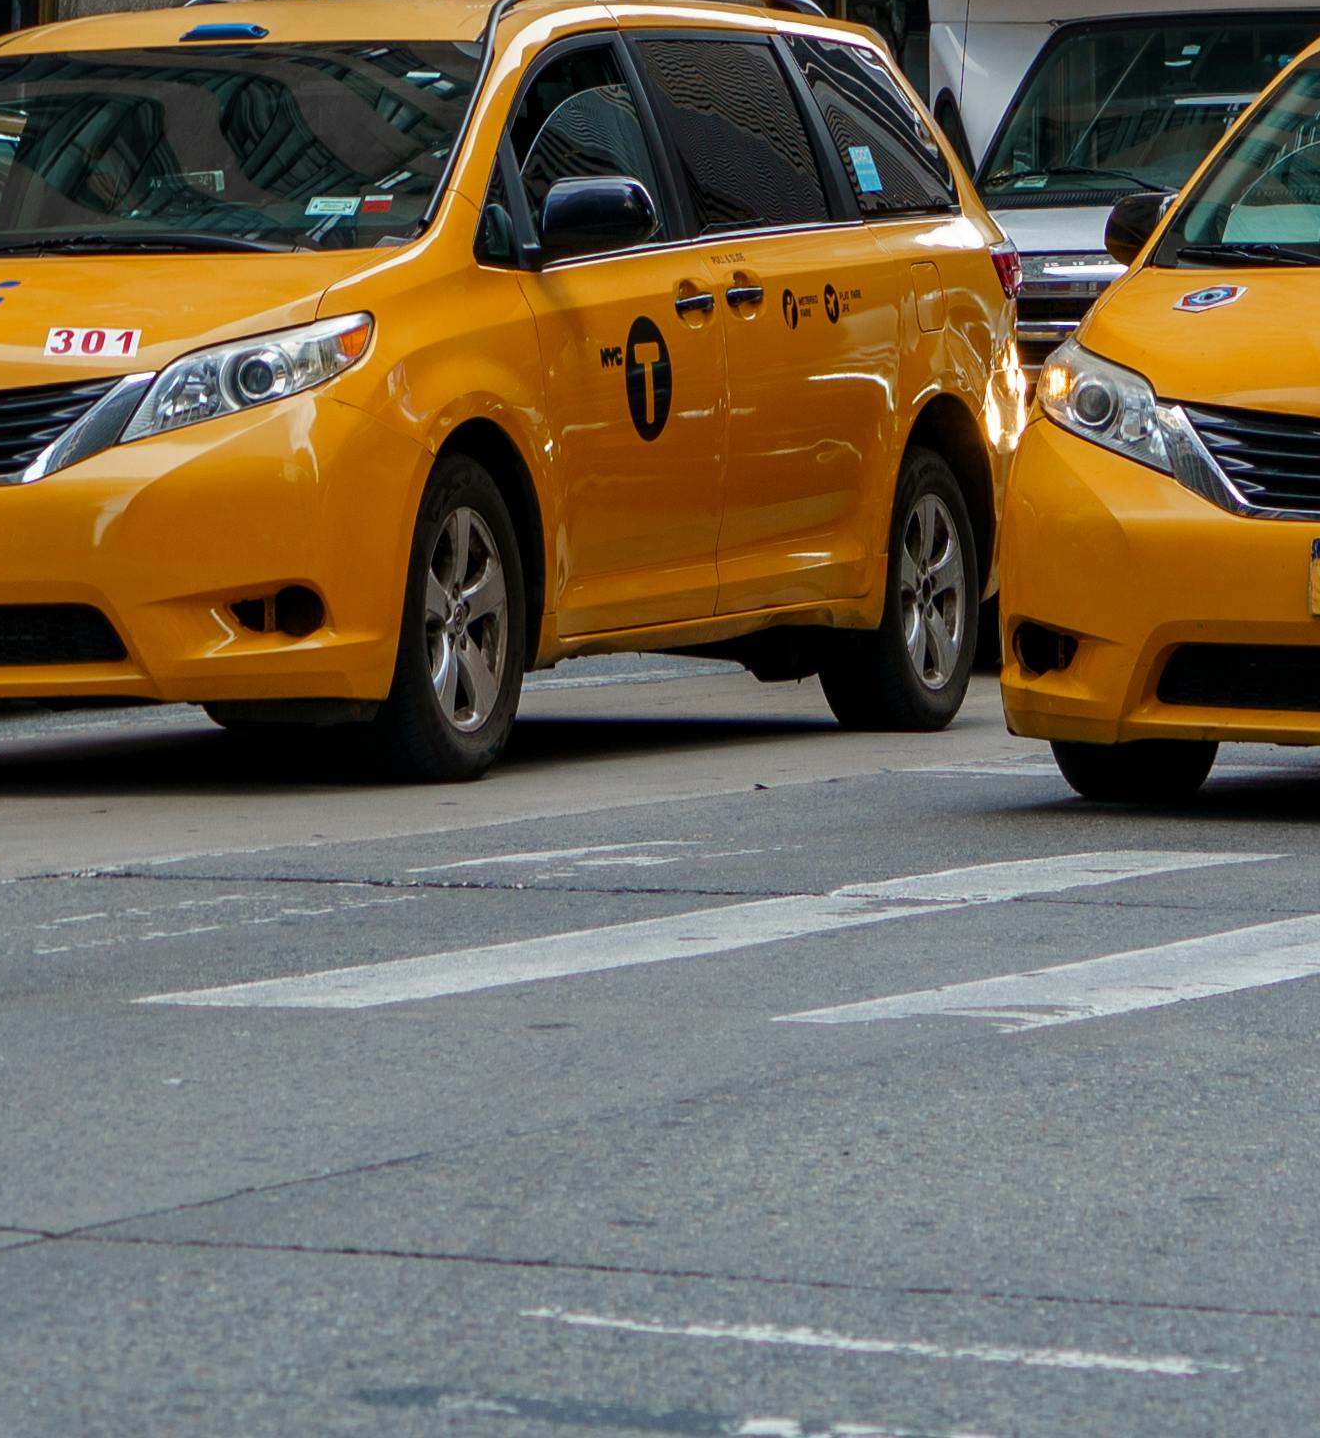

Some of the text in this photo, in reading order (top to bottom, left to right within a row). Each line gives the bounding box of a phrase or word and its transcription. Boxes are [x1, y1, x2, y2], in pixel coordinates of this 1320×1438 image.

[50, 329, 134, 355] 301
[600, 341, 660, 424] NYC T
